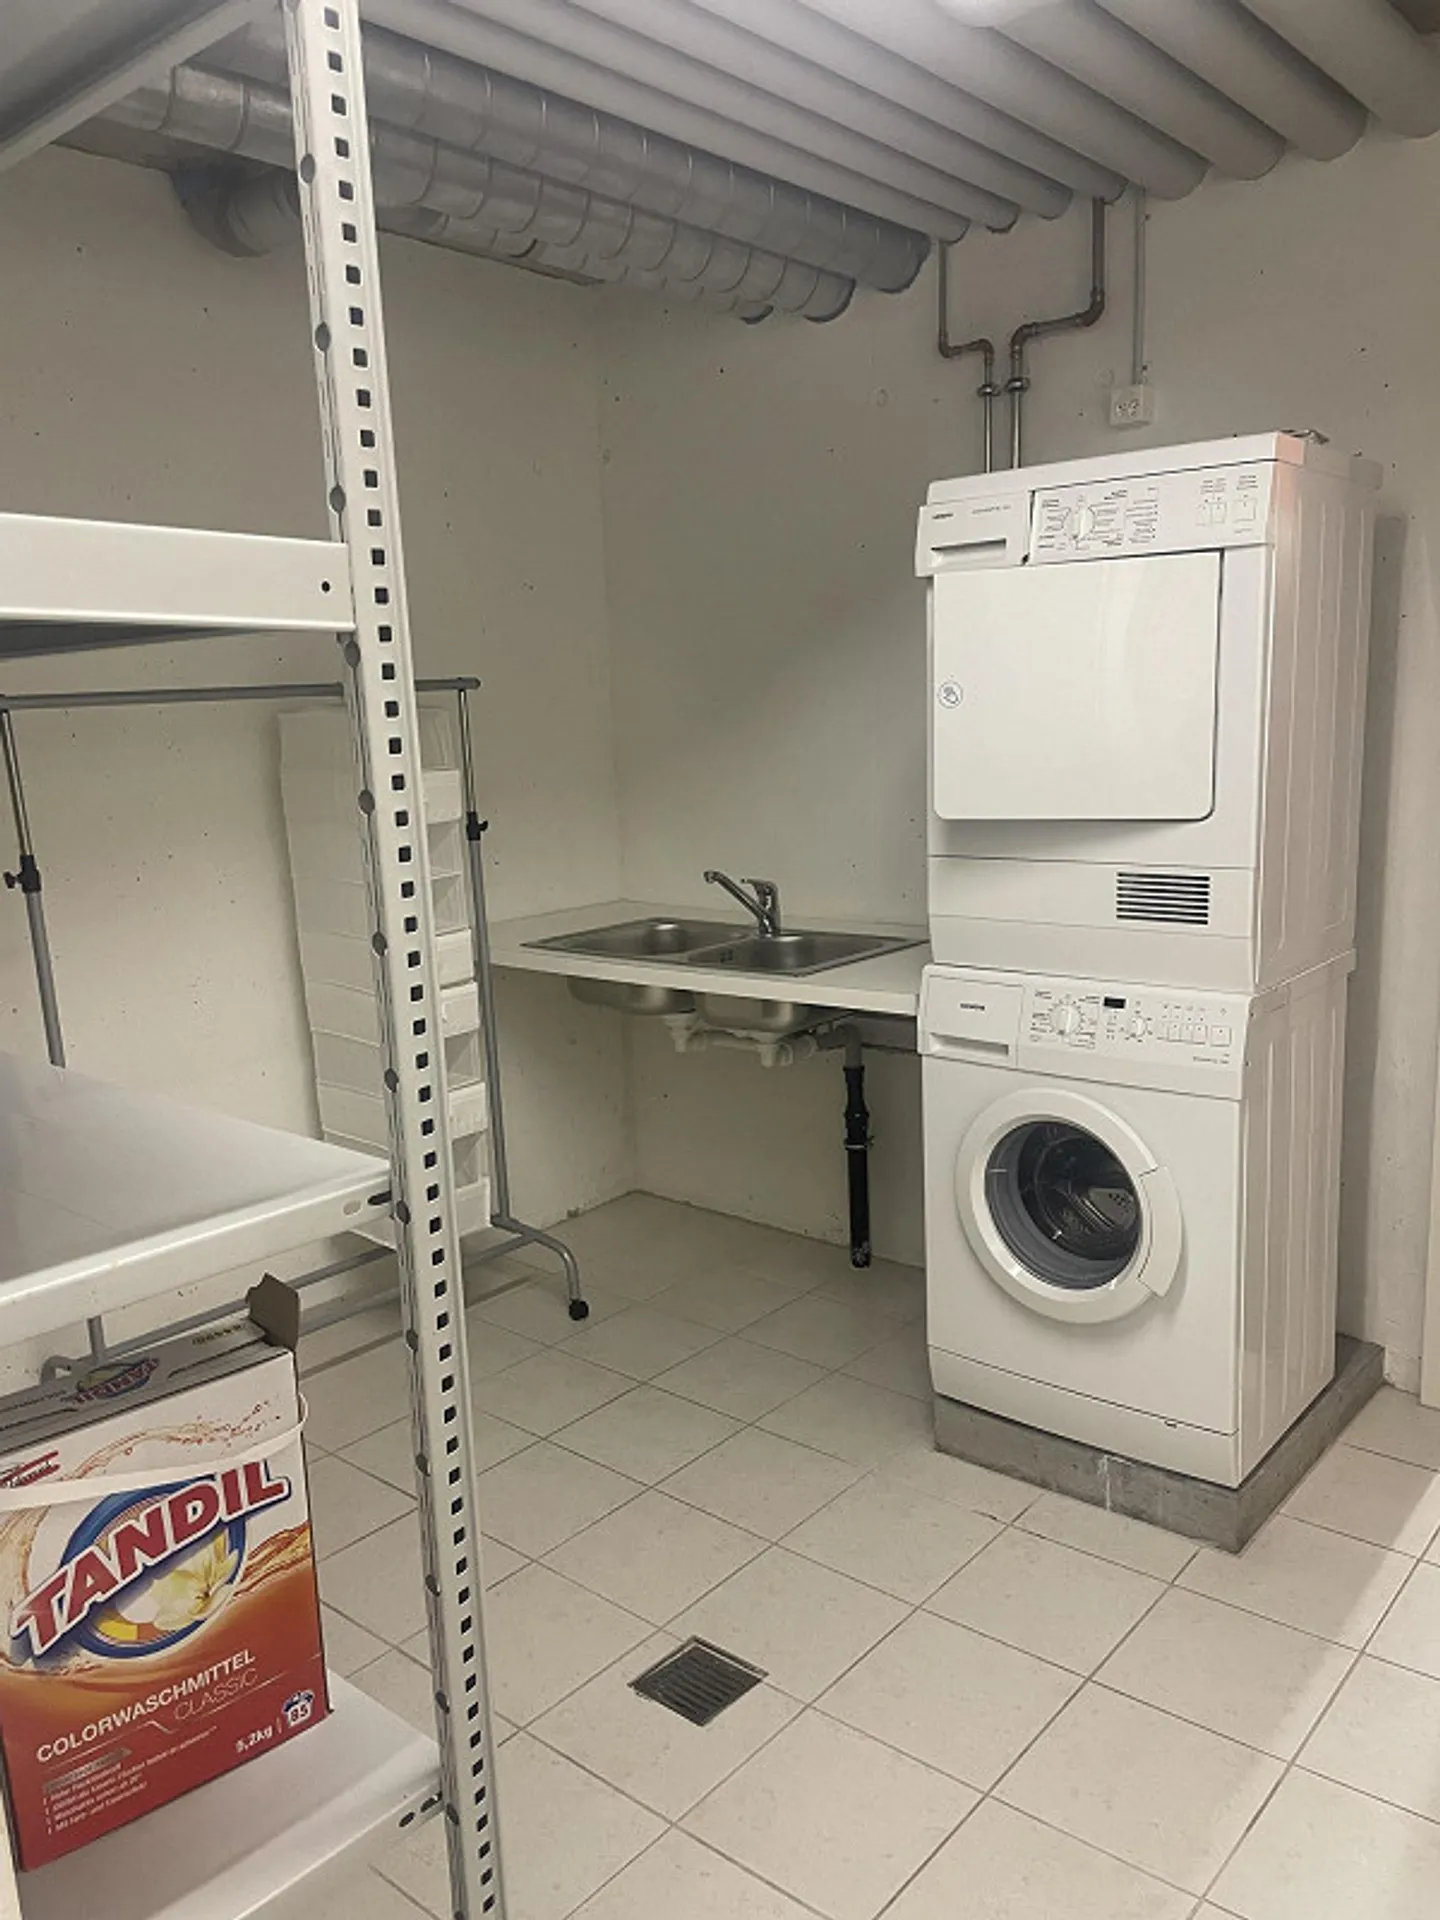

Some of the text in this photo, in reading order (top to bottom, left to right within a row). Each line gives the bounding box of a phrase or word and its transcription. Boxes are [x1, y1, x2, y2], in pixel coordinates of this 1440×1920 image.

[13, 1459, 288, 1652] TANDIL
[36, 1648, 256, 1763] COLORWASCHMITTEL
[173, 1667, 259, 1720] CLASSIC
